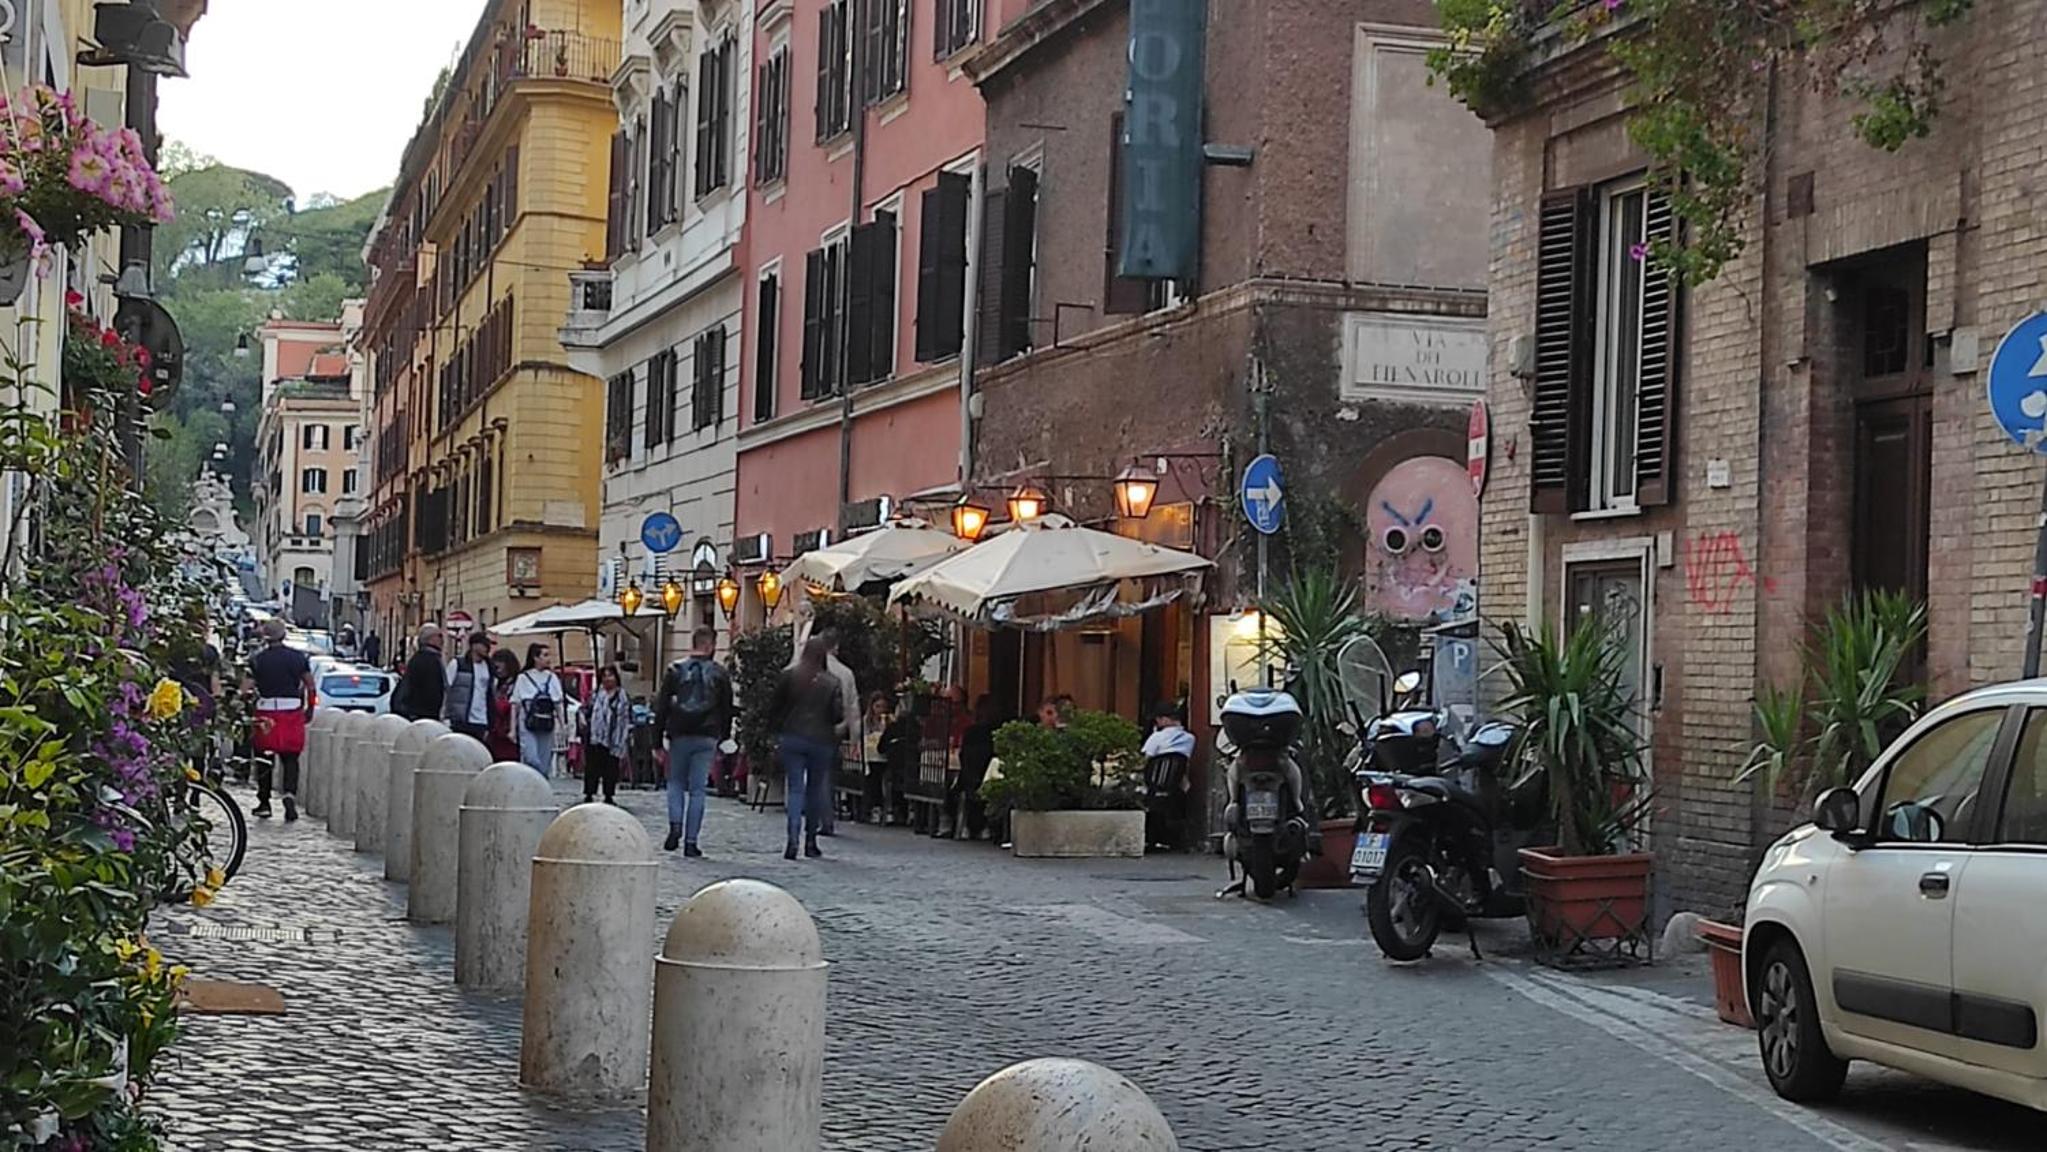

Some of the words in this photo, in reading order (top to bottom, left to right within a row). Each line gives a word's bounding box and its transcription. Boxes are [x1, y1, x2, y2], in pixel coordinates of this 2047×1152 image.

[1126, 0, 1181, 274] ORIA
[1412, 329, 1447, 349] VIA
[1416, 350, 1441, 365] DEI
[1453, 643, 1469, 669] P
